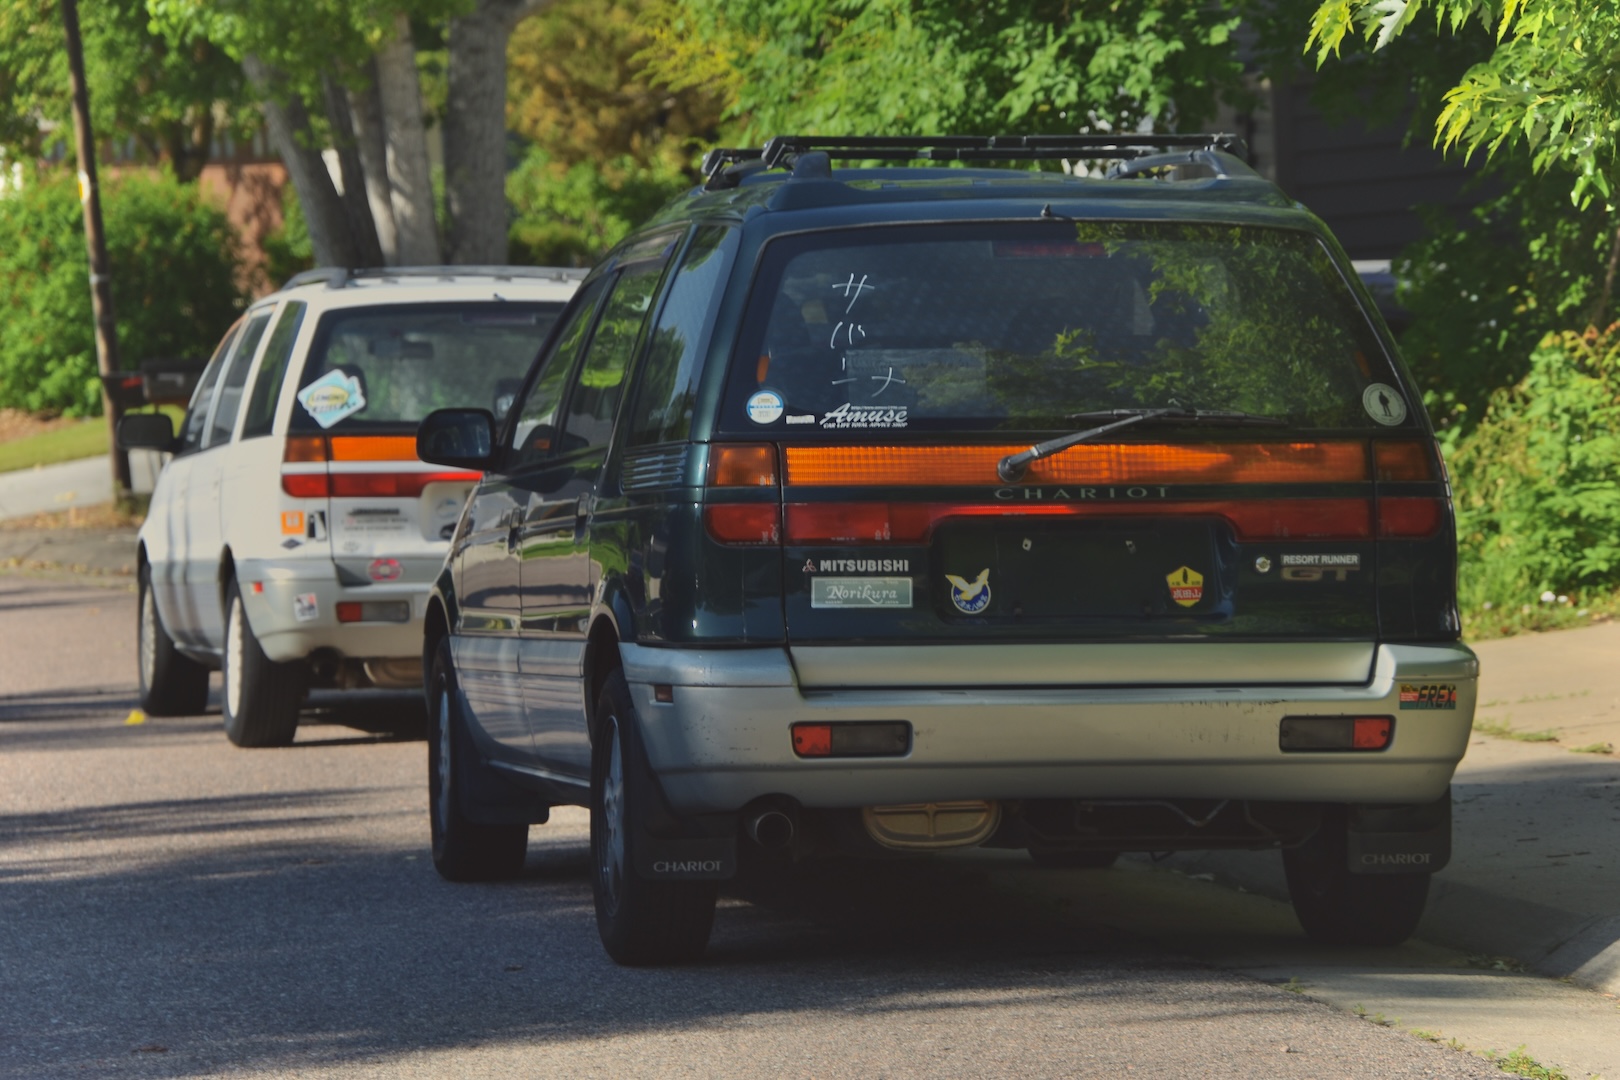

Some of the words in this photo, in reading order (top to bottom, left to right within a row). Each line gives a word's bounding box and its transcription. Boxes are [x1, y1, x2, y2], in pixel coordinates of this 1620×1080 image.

[820, 402, 909, 426] Amuse
[995, 488, 1167, 499] CHARIOT
[820, 559, 910, 572] MITSUBISHI
[1283, 555, 1320, 565] RESORT
[1321, 555, 1359, 565] RUNNER
[1281, 567, 1360, 581] GT
[827, 585, 898, 604] Norikura
[1361, 853, 1432, 864] CHARIOT
[653, 861, 722, 872] CHARIOT
